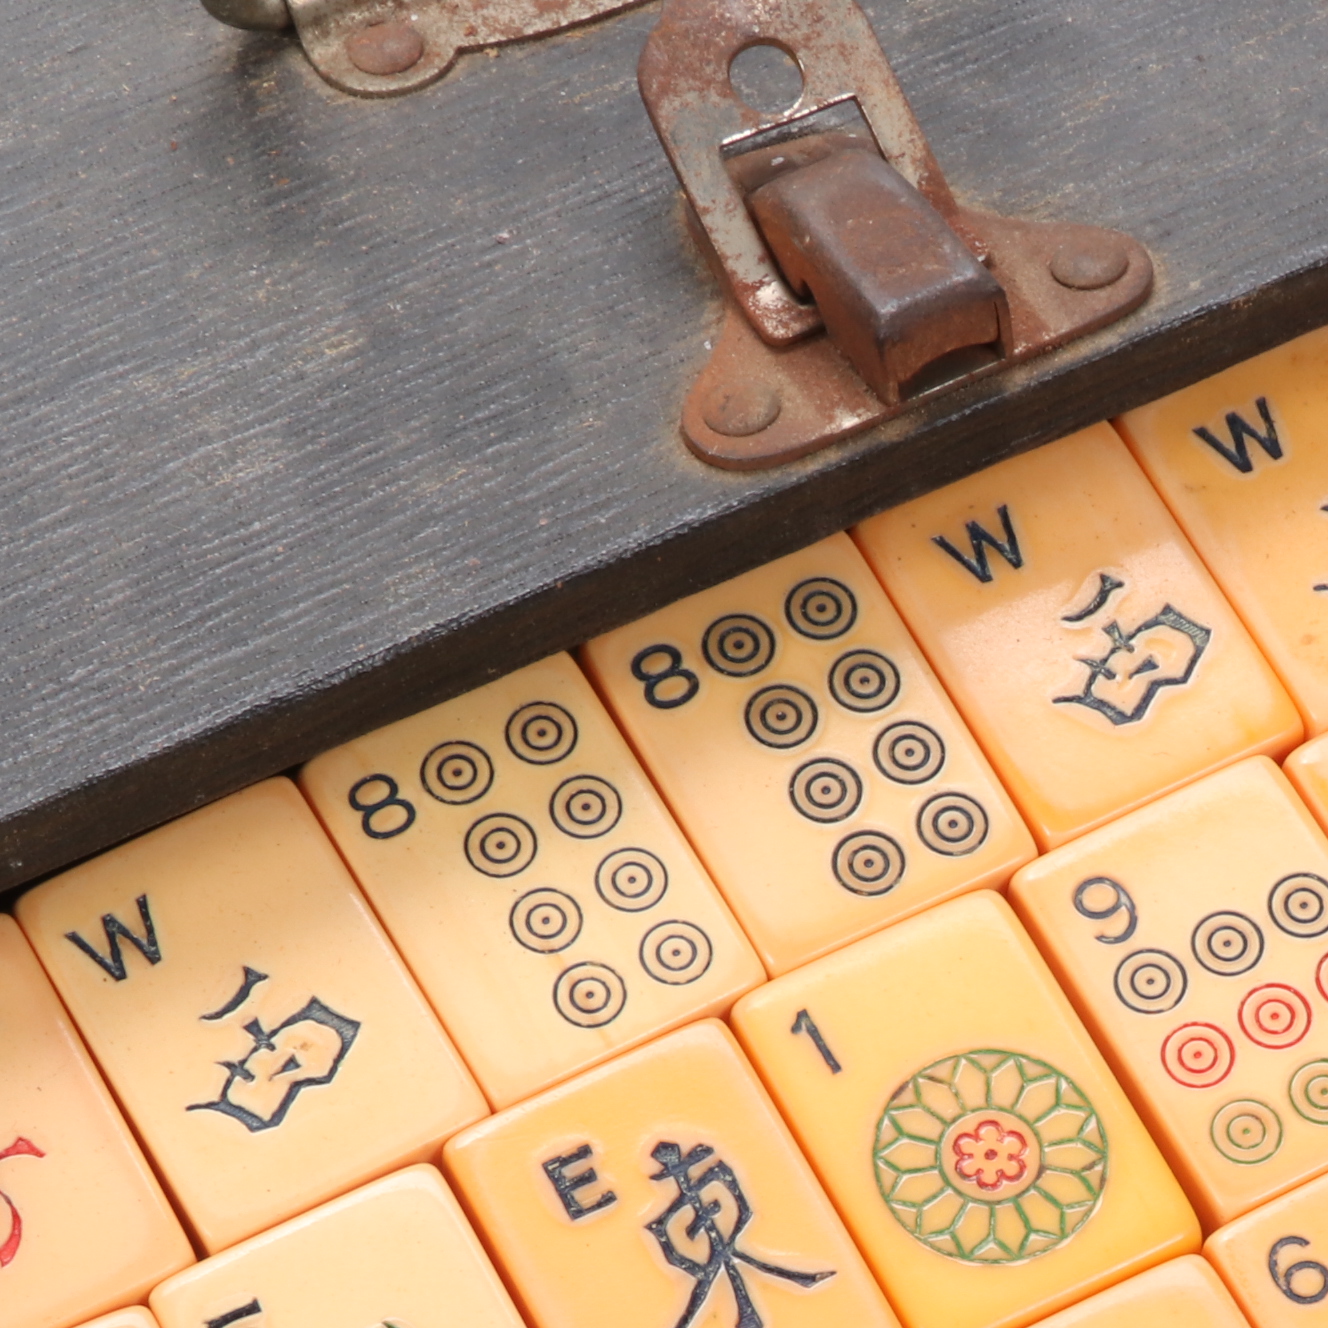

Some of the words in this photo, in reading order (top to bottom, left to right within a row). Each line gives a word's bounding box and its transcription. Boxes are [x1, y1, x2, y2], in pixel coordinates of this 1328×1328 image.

[1192, 397, 1283, 474] W
[931, 504, 1022, 583] W
[630, 643, 700, 710] 8
[347, 773, 416, 840] 8
[64, 893, 162, 982] W
[1071, 875, 1138, 945] 9
[789, 1008, 843, 1075] 1
[541, 1143, 618, 1222] E
